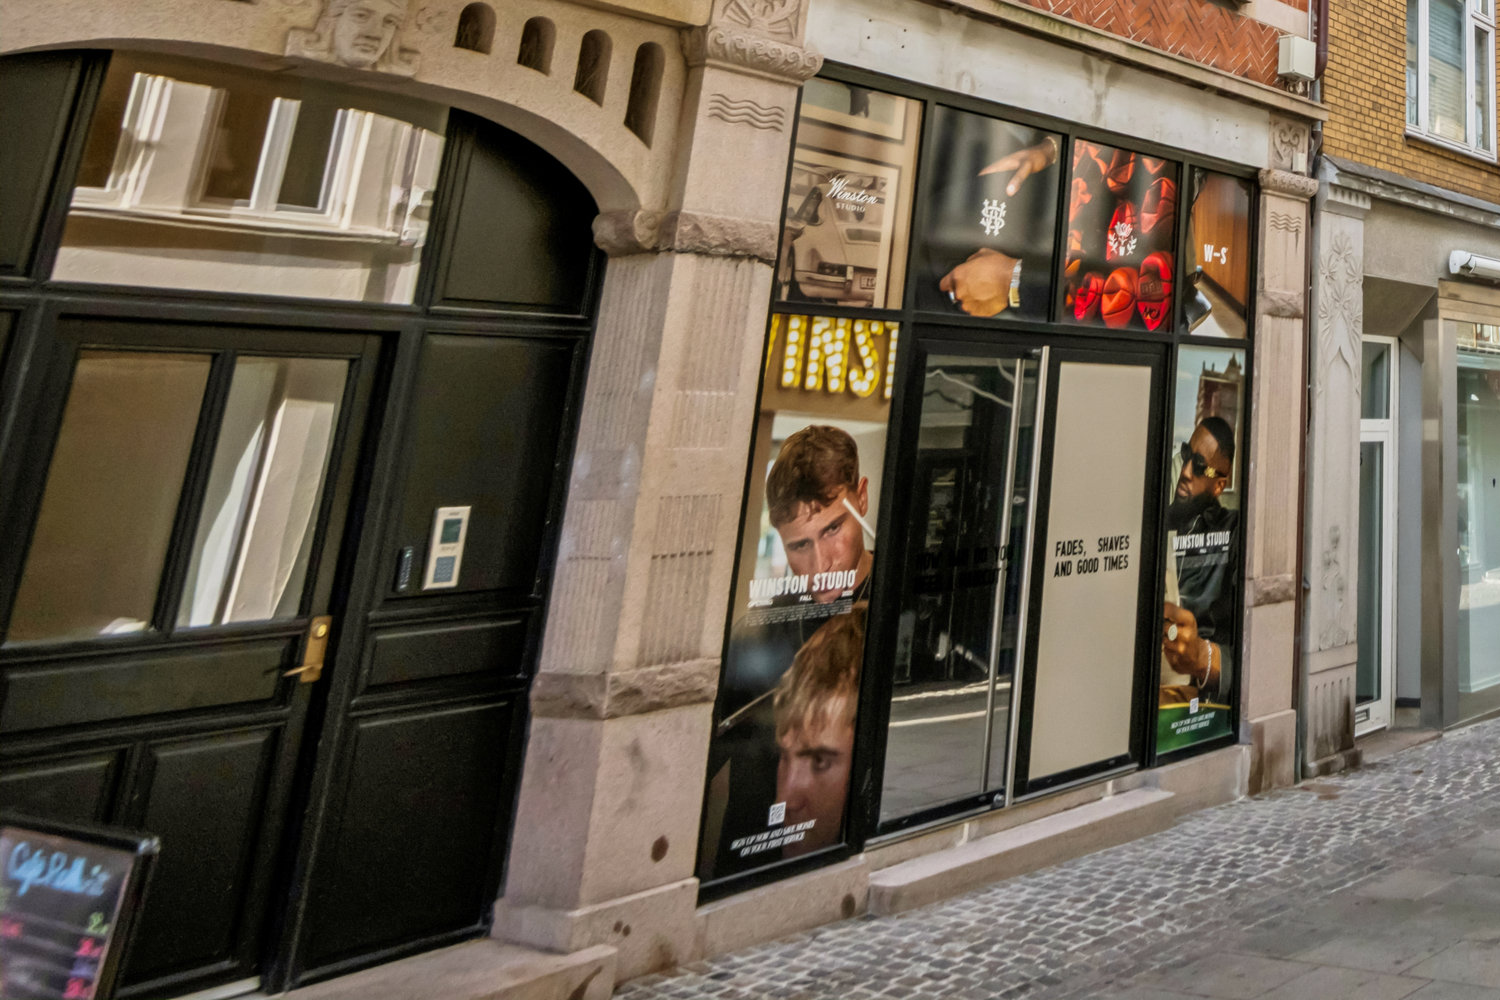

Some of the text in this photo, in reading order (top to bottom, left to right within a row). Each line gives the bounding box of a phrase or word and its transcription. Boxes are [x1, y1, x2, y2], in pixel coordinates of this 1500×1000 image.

[826, 174, 879, 205] Winston
[836, 202, 866, 212] STUDIO
[1055, 535, 1130, 558] FADES, SHAVES
[1172, 531, 1230, 550] WINSTON STUDIO
[1053, 554, 1129, 578] AND GOOD TIMES
[749, 570, 856, 600] WINSTON STUDIO
